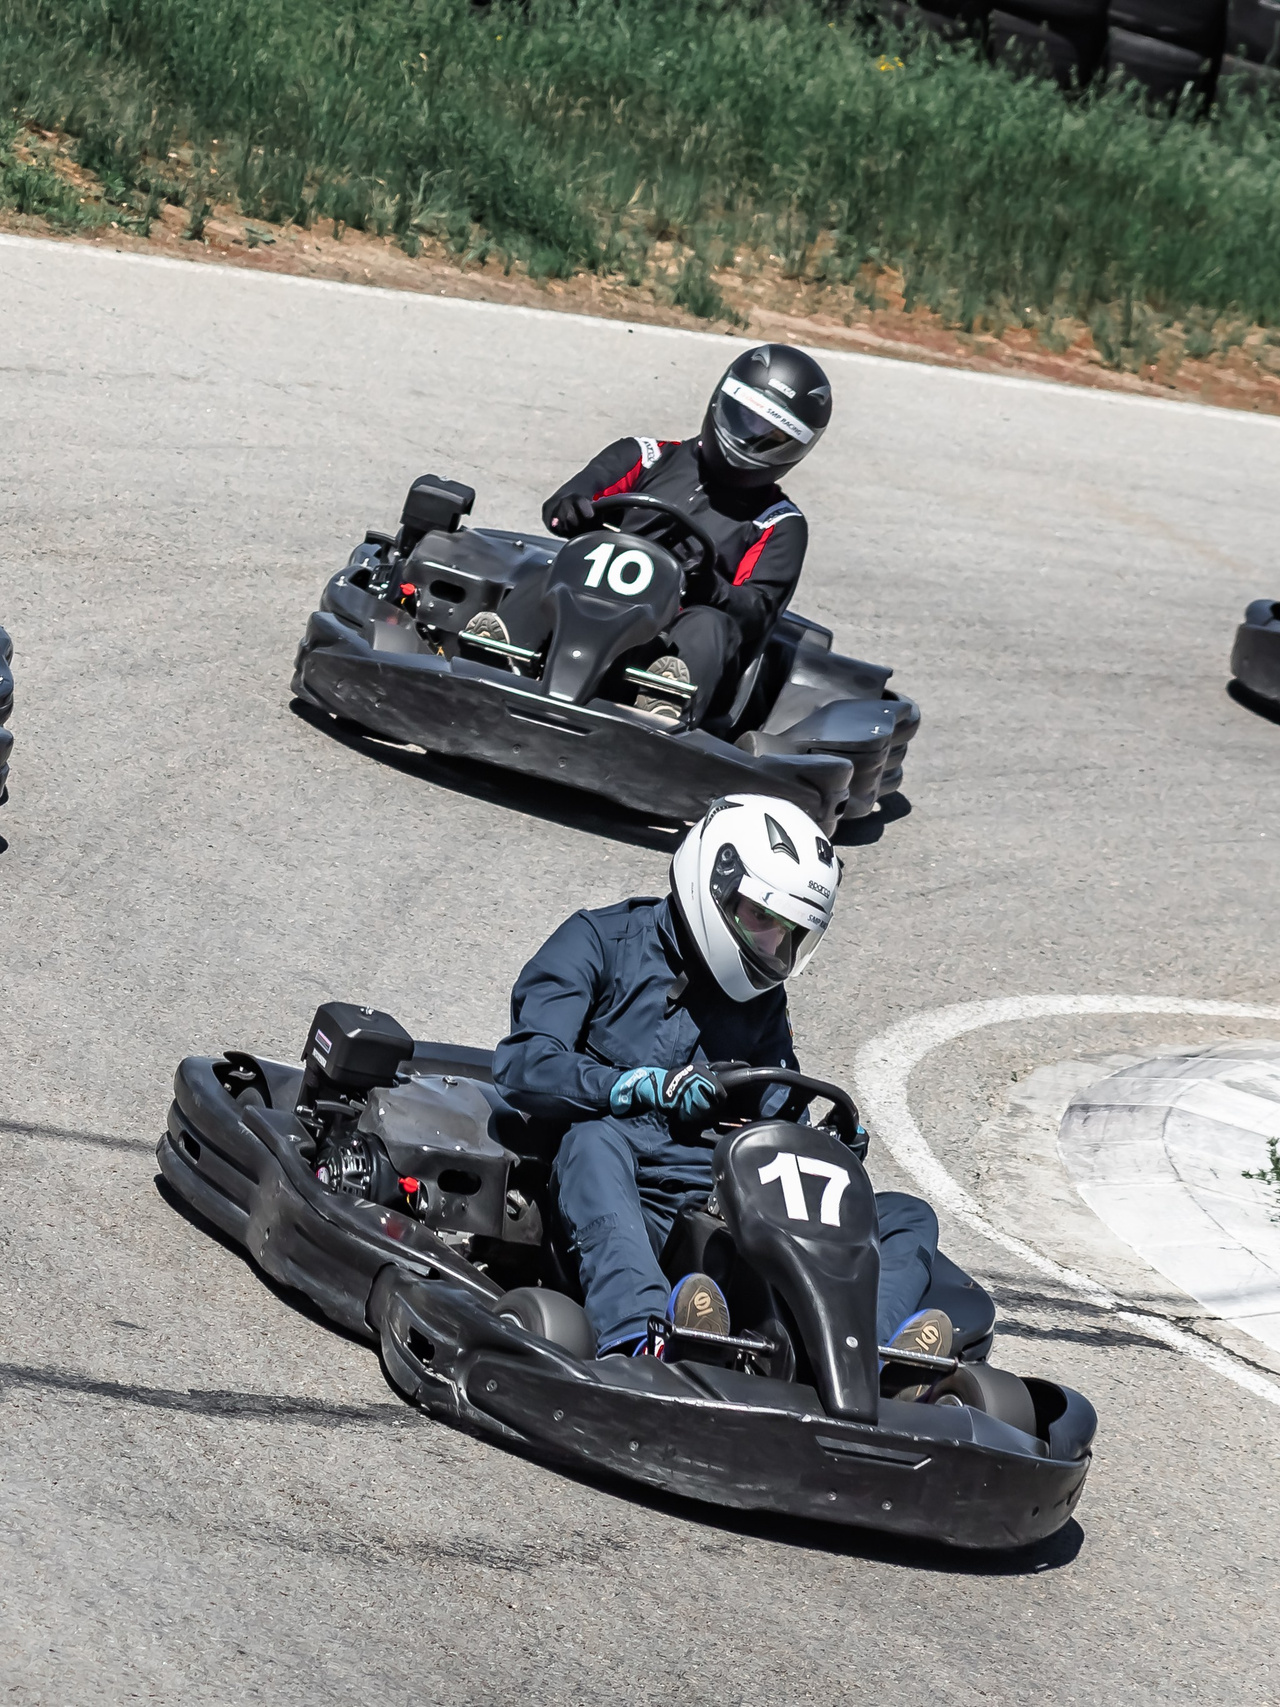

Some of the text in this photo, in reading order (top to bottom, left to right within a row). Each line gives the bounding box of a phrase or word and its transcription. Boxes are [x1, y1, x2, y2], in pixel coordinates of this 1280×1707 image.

[766, 408, 802, 436] SMP RACING
[583, 542, 654, 596] 10
[807, 880, 831, 899] sparco
[758, 1152, 851, 1228] 17
